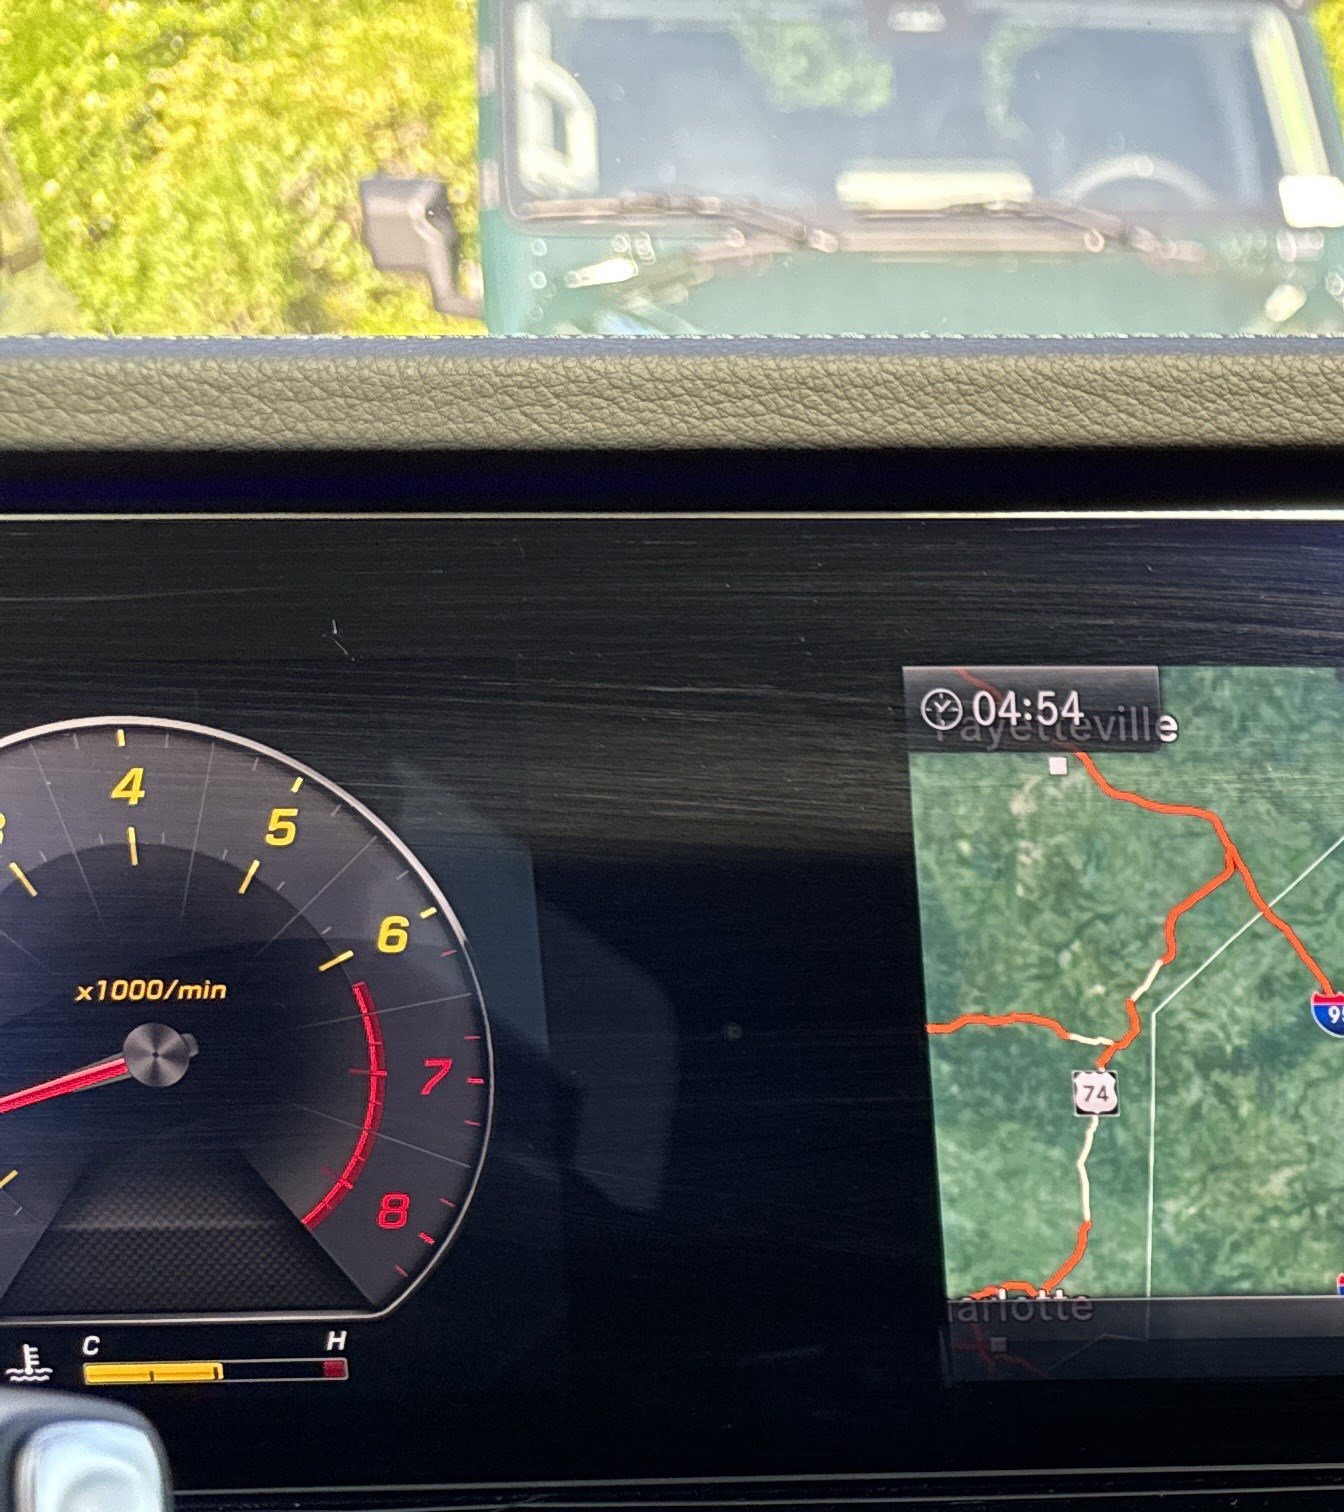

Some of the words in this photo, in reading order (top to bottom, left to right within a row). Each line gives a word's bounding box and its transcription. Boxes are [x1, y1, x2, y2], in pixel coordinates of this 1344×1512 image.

[972, 689, 1085, 727] 04:54
[111, 767, 145, 805] 4
[265, 808, 298, 847] 5
[377, 915, 410, 953] 6
[75, 977, 228, 1004] x1000/min
[420, 1058, 453, 1096] 7
[1083, 1084, 1109, 1103] 74
[377, 1193, 411, 1230] 8
[82, 1335, 100, 1357] C
[326, 1330, 347, 1351] H
